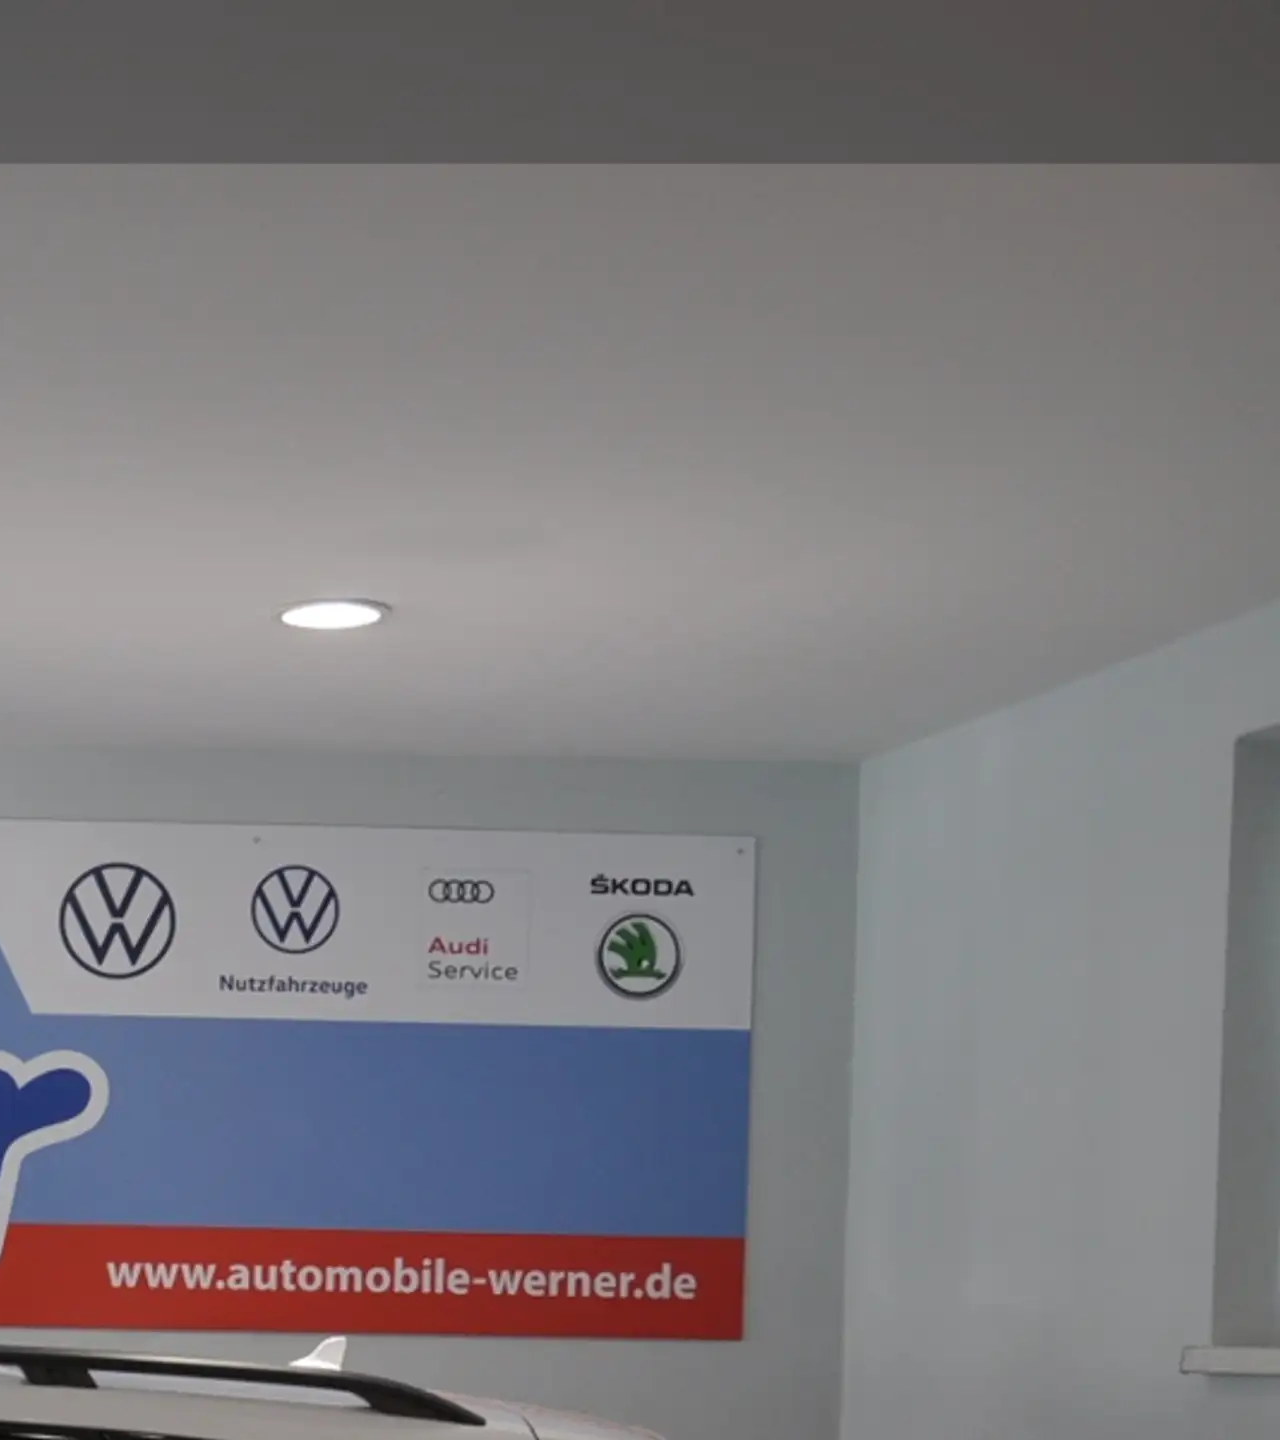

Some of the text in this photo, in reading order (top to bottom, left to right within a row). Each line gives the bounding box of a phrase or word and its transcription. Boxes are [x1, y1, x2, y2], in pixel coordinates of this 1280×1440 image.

[589, 873, 695, 898] ŠKODA
[428, 936, 490, 957] Audi
[428, 959, 519, 982] Service
[219, 973, 368, 999] Nutzfahrzeuge
[107, 1257, 697, 1301] www.automobile-werner.de
